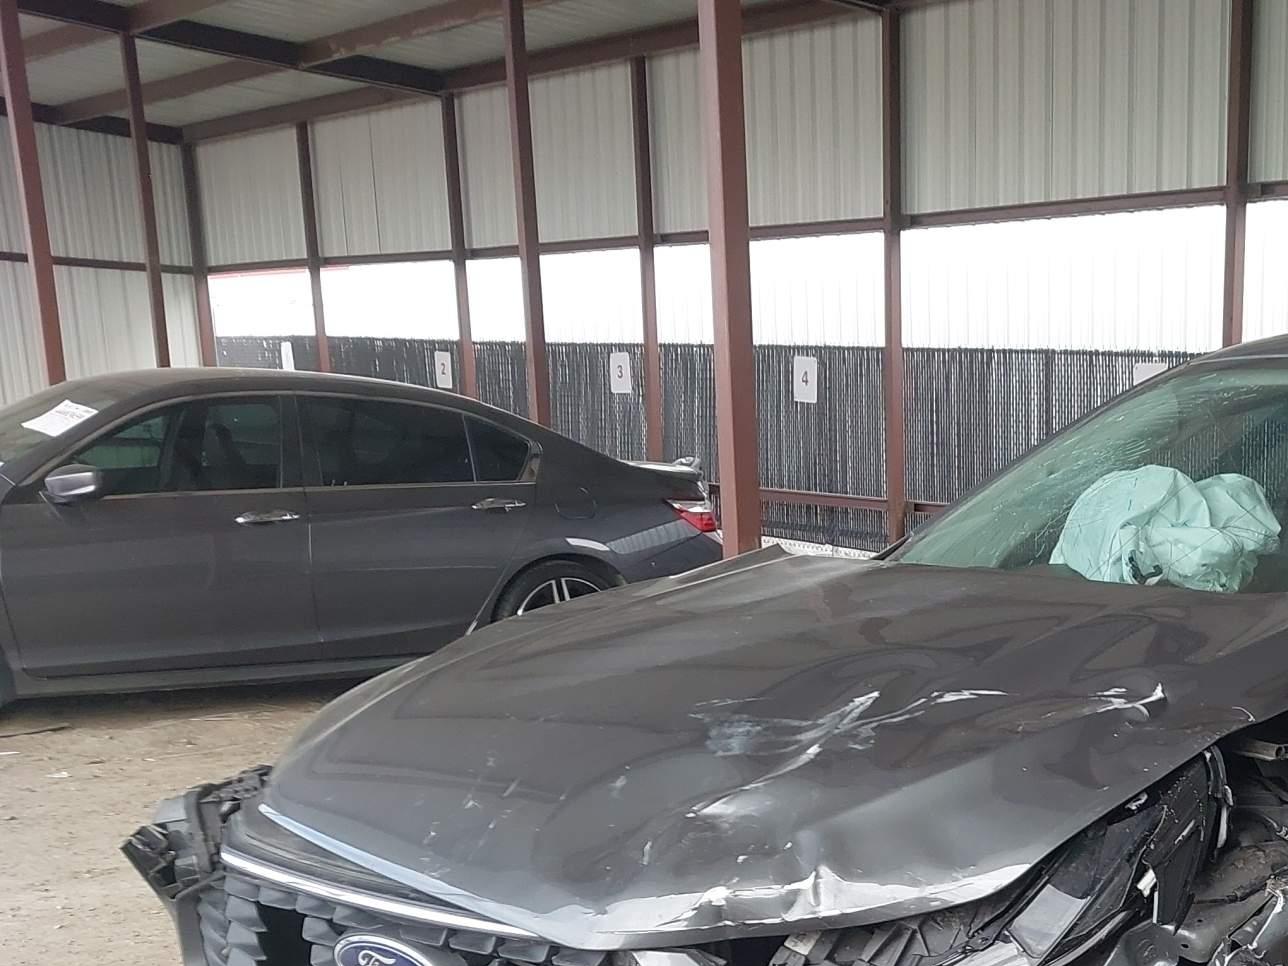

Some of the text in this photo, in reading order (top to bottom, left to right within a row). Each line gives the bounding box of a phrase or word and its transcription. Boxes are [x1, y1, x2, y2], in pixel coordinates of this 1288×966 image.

[440, 362, 446, 376] 2
[616, 364, 623, 379] 3
[801, 370, 809, 386] 4
